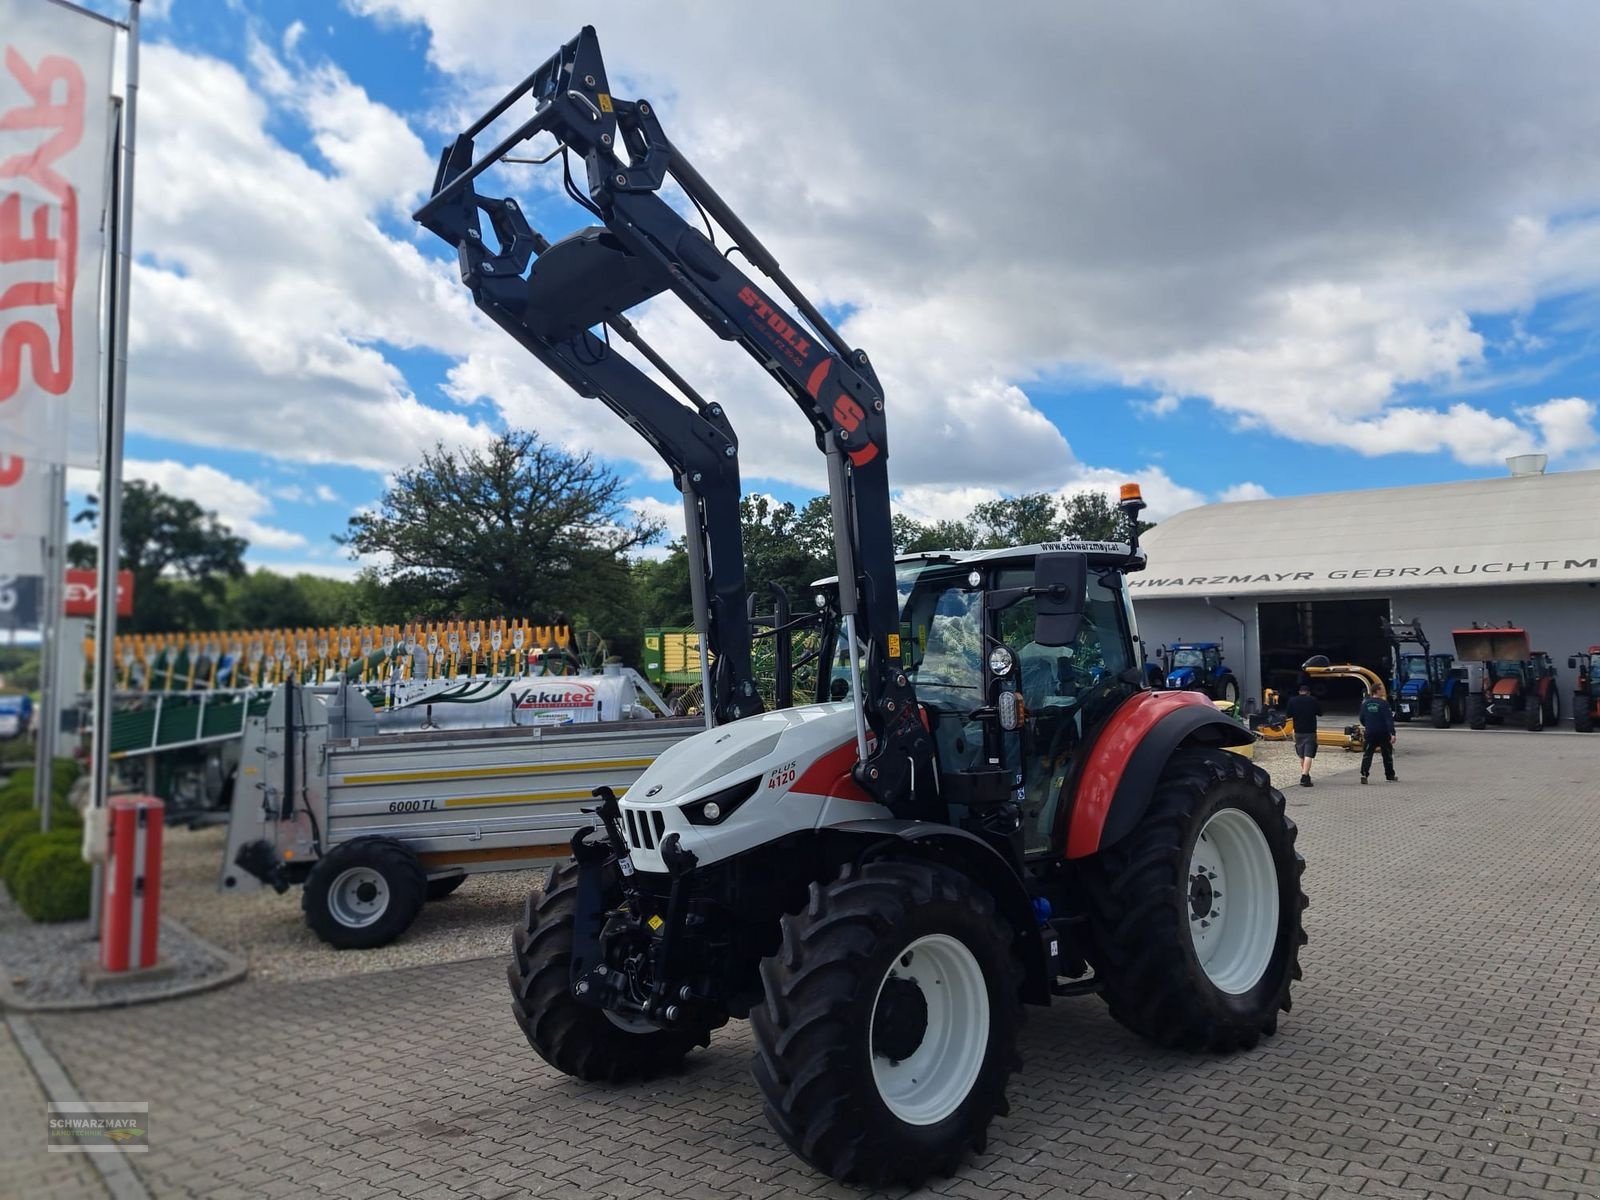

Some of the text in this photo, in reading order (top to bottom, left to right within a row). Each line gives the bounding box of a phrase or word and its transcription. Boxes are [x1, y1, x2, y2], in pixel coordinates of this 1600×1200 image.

[737, 286, 811, 358] STOLL
[1040, 542, 1120, 552] www.schwarzmayr.at
[510, 688, 595, 708] Vakutec
[771, 760, 796, 777] PLUS
[768, 769, 795, 789] 4120
